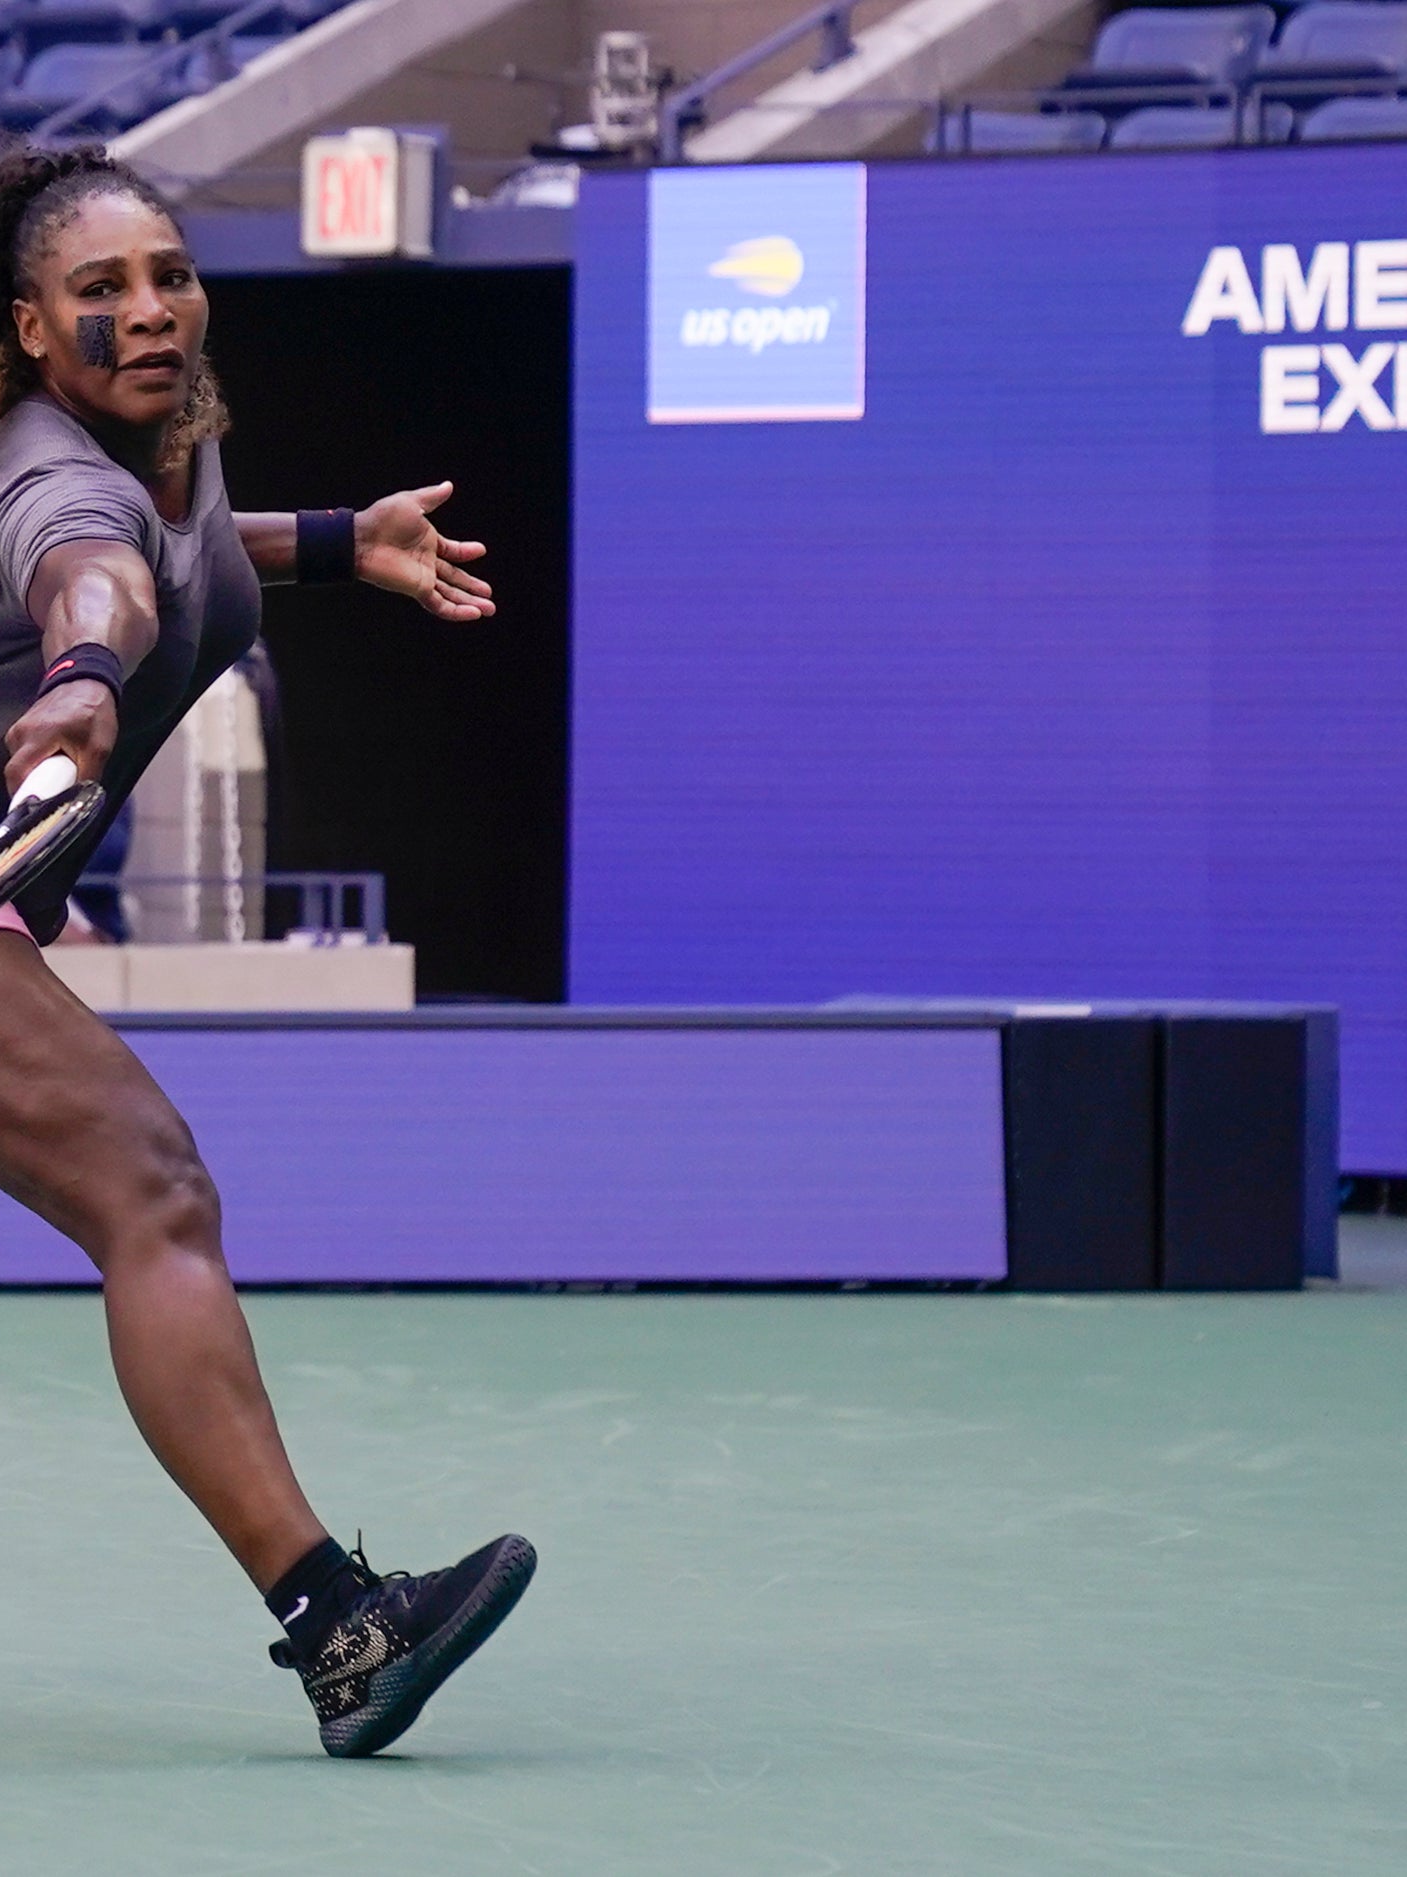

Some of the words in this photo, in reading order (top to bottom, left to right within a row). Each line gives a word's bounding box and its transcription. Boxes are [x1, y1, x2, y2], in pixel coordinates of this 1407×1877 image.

[319, 156, 387, 240] EXIT
[683, 308, 730, 347] us
[730, 305, 830, 353] open
[1181, 239, 1407, 337] AME
[1259, 341, 1407, 434] EX
